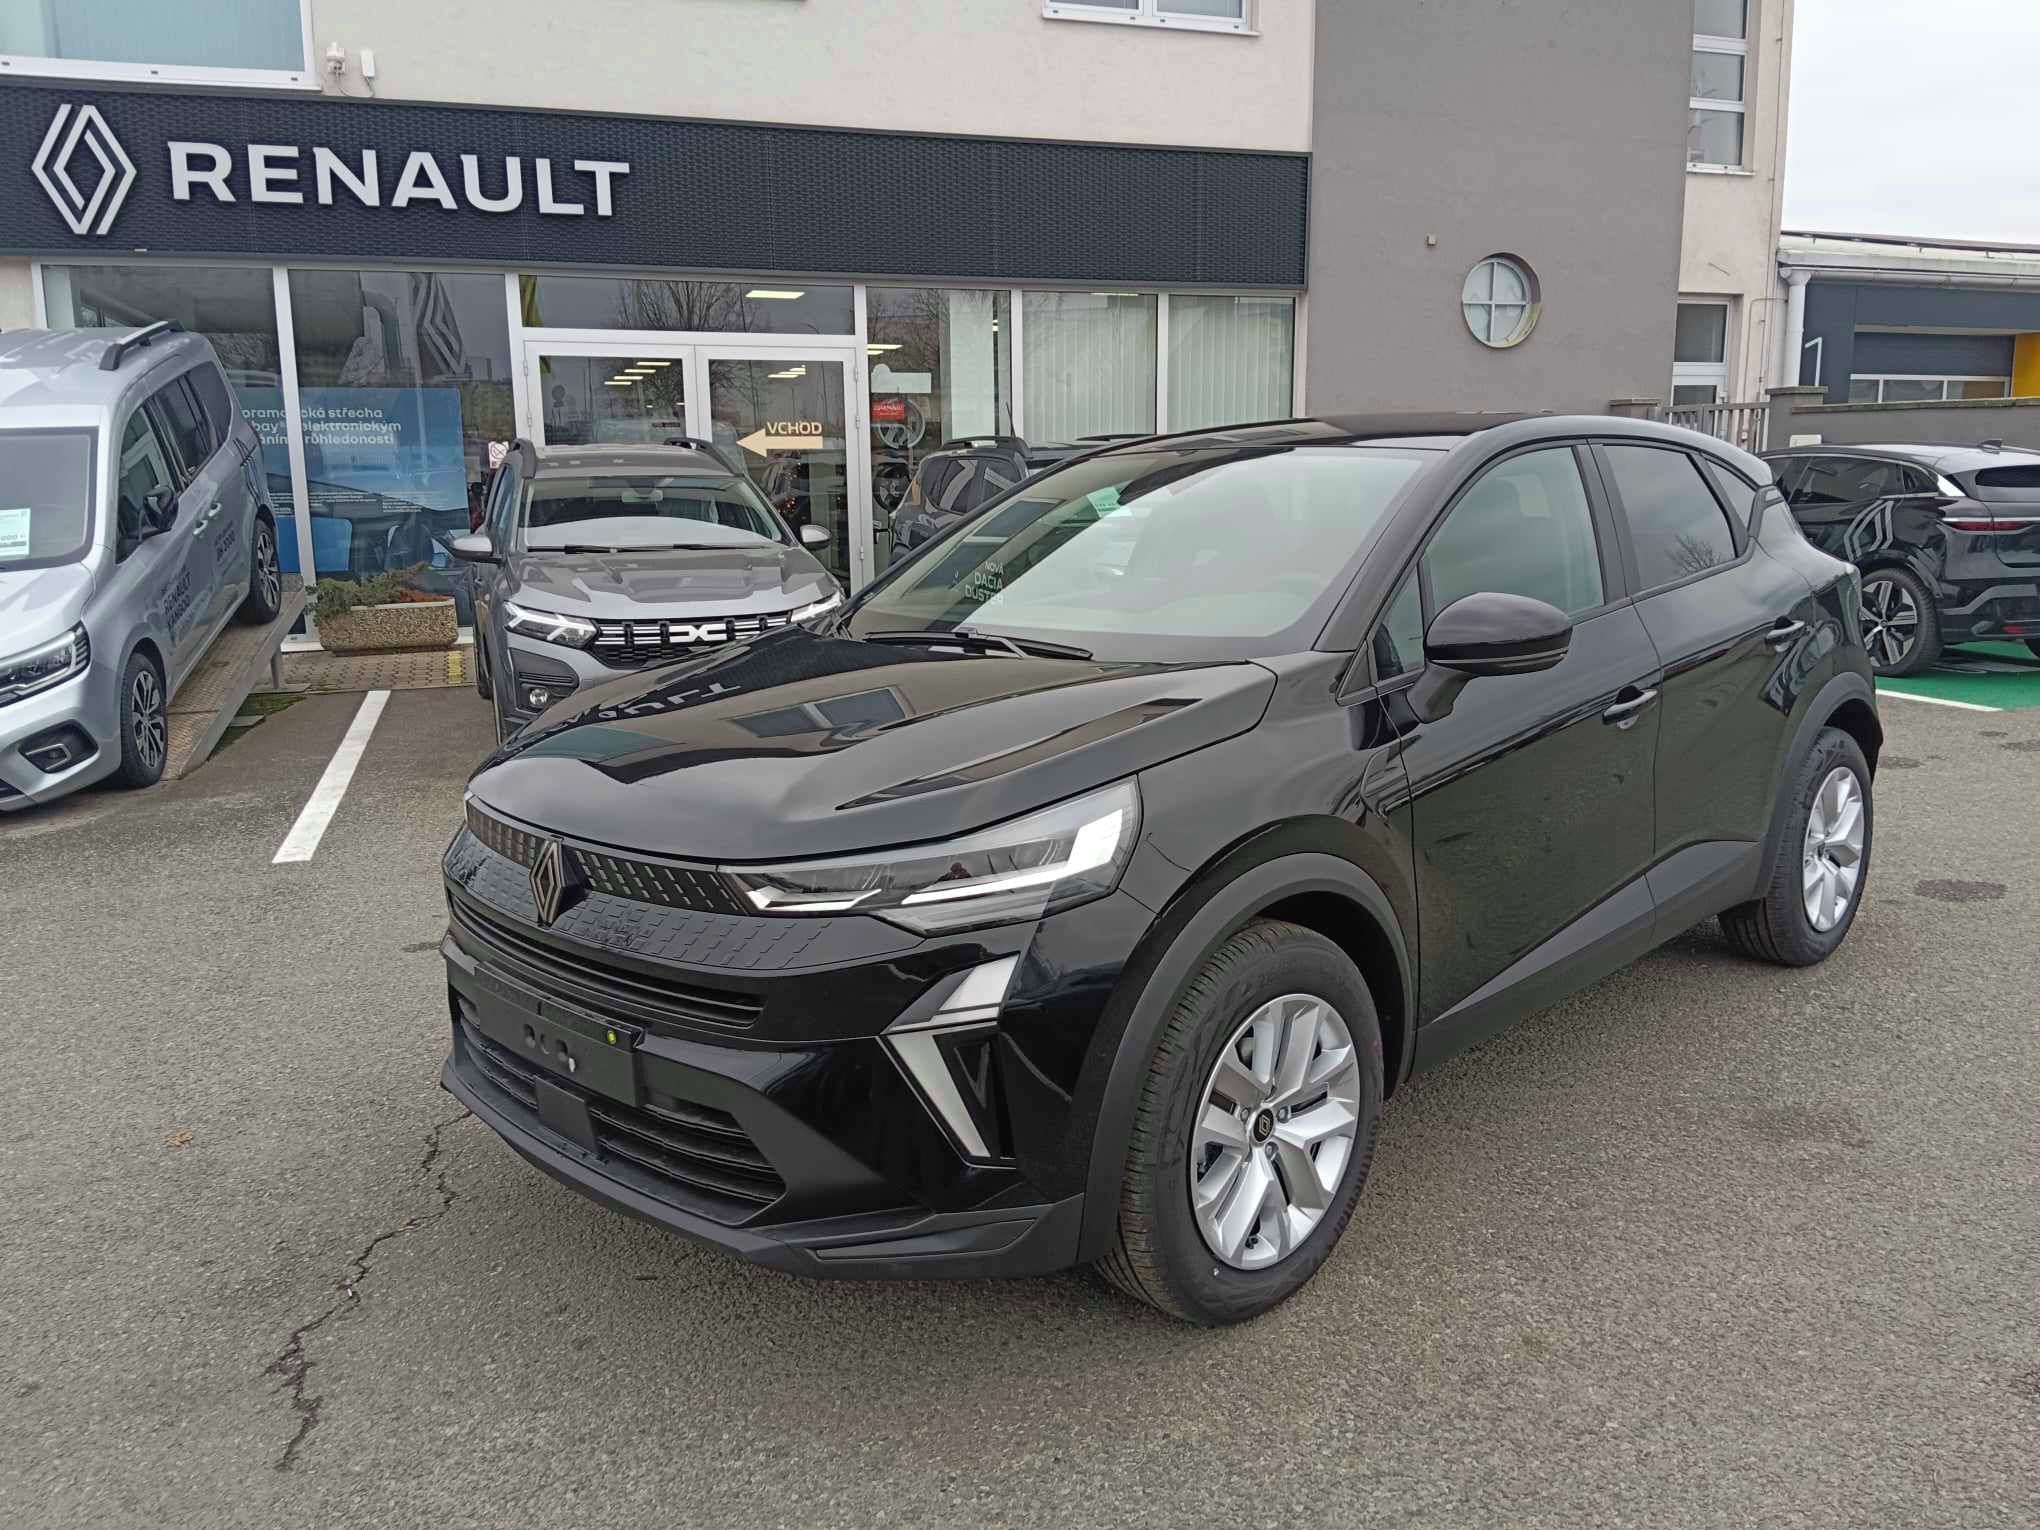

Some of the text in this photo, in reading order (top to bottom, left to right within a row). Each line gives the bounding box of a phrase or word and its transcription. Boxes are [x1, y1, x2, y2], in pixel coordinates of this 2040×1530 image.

[167, 140, 631, 217] RENAULT
[328, 406, 383, 419] střecha
[766, 421, 823, 435] VCHOD
[974, 571, 1003, 591] DACIA
